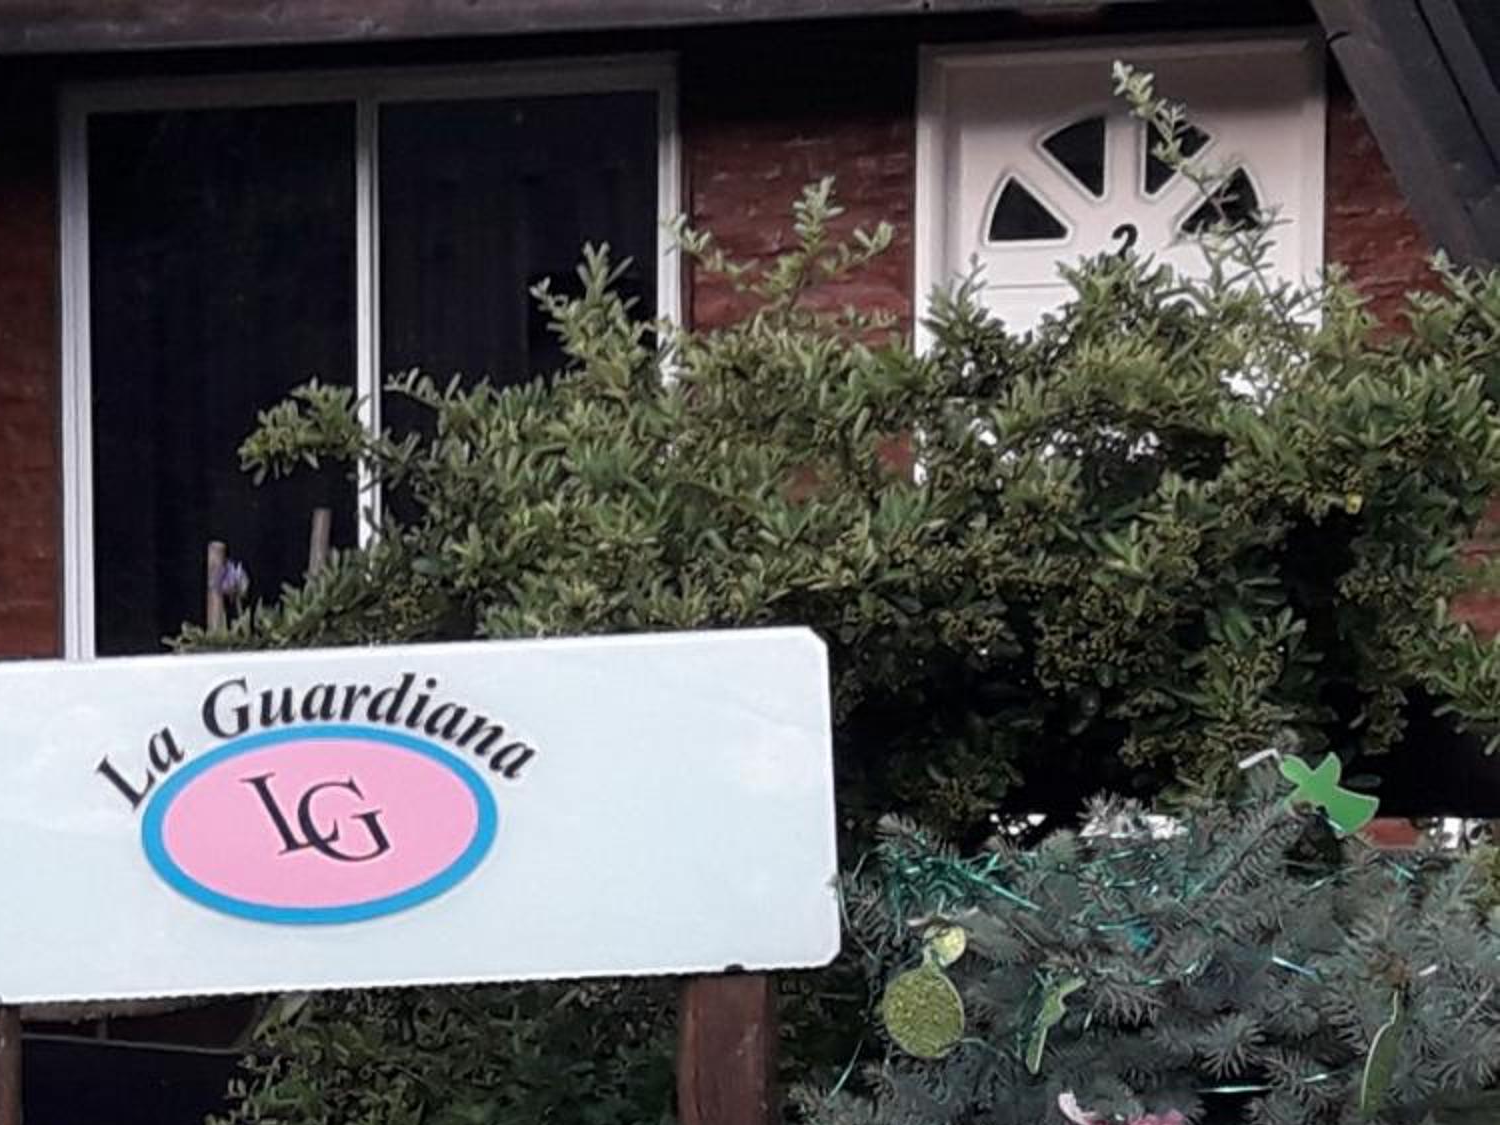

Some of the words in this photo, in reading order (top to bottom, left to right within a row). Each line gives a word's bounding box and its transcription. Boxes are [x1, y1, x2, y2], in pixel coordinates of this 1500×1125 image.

[95, 726, 186, 811] La
[202, 671, 536, 780] Guardiana
[241, 771, 392, 864] LG
